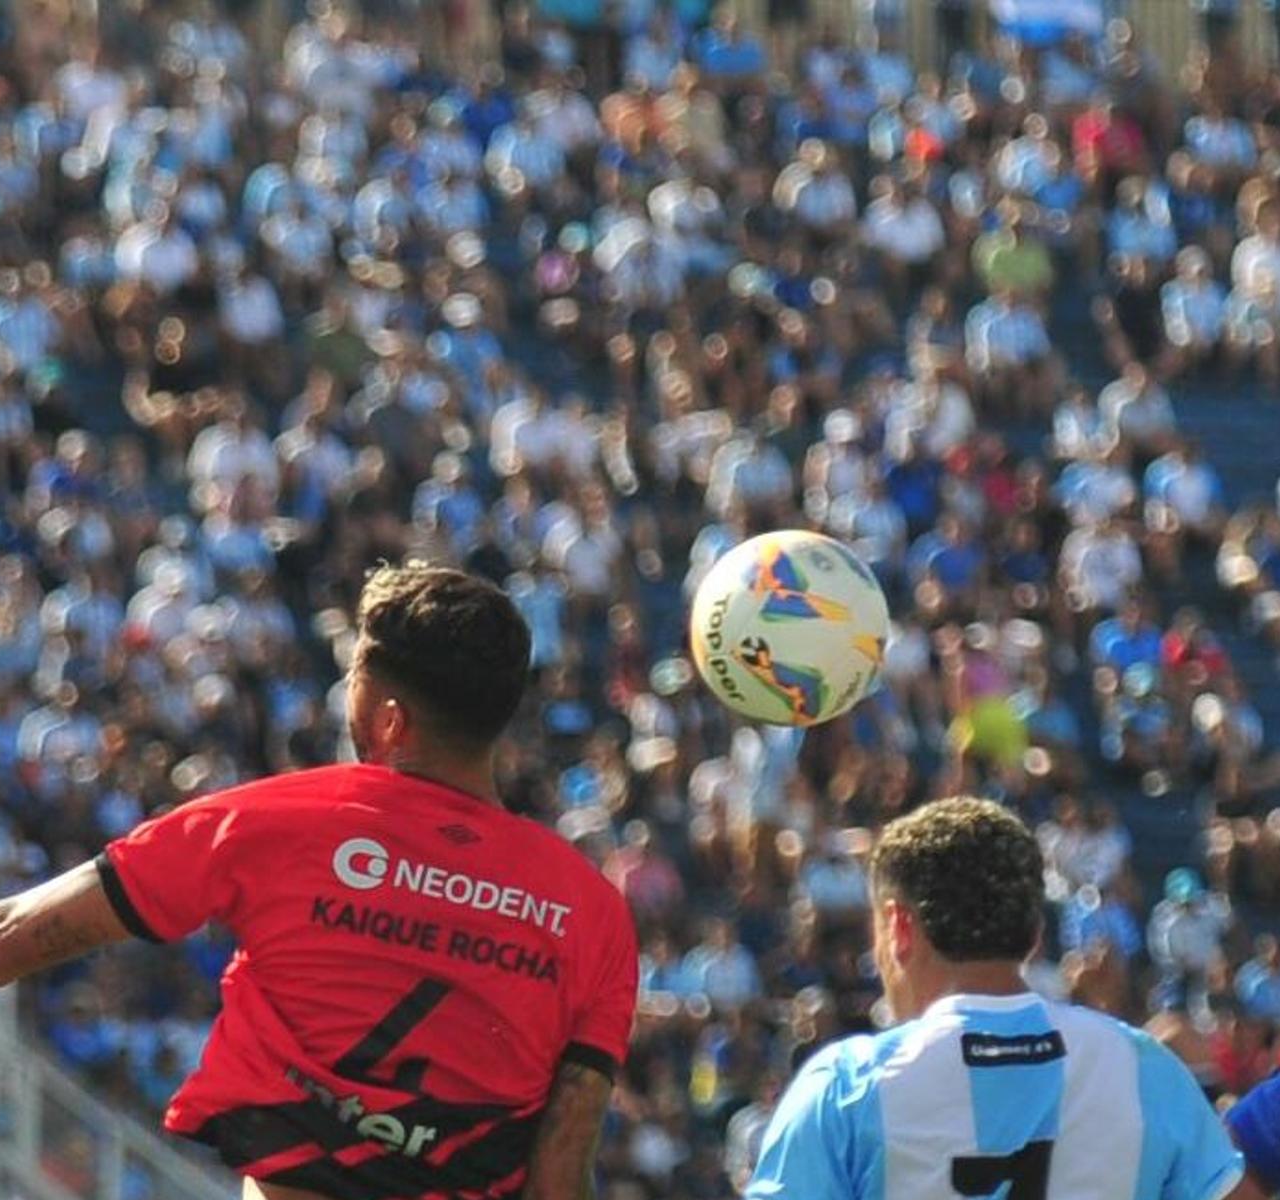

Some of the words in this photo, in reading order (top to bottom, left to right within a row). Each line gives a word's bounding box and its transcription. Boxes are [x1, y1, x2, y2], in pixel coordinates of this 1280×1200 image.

[393, 859, 571, 937] NEODENT
[310, 897, 439, 952] KAIQUE
[449, 930, 558, 985] ROCHA
